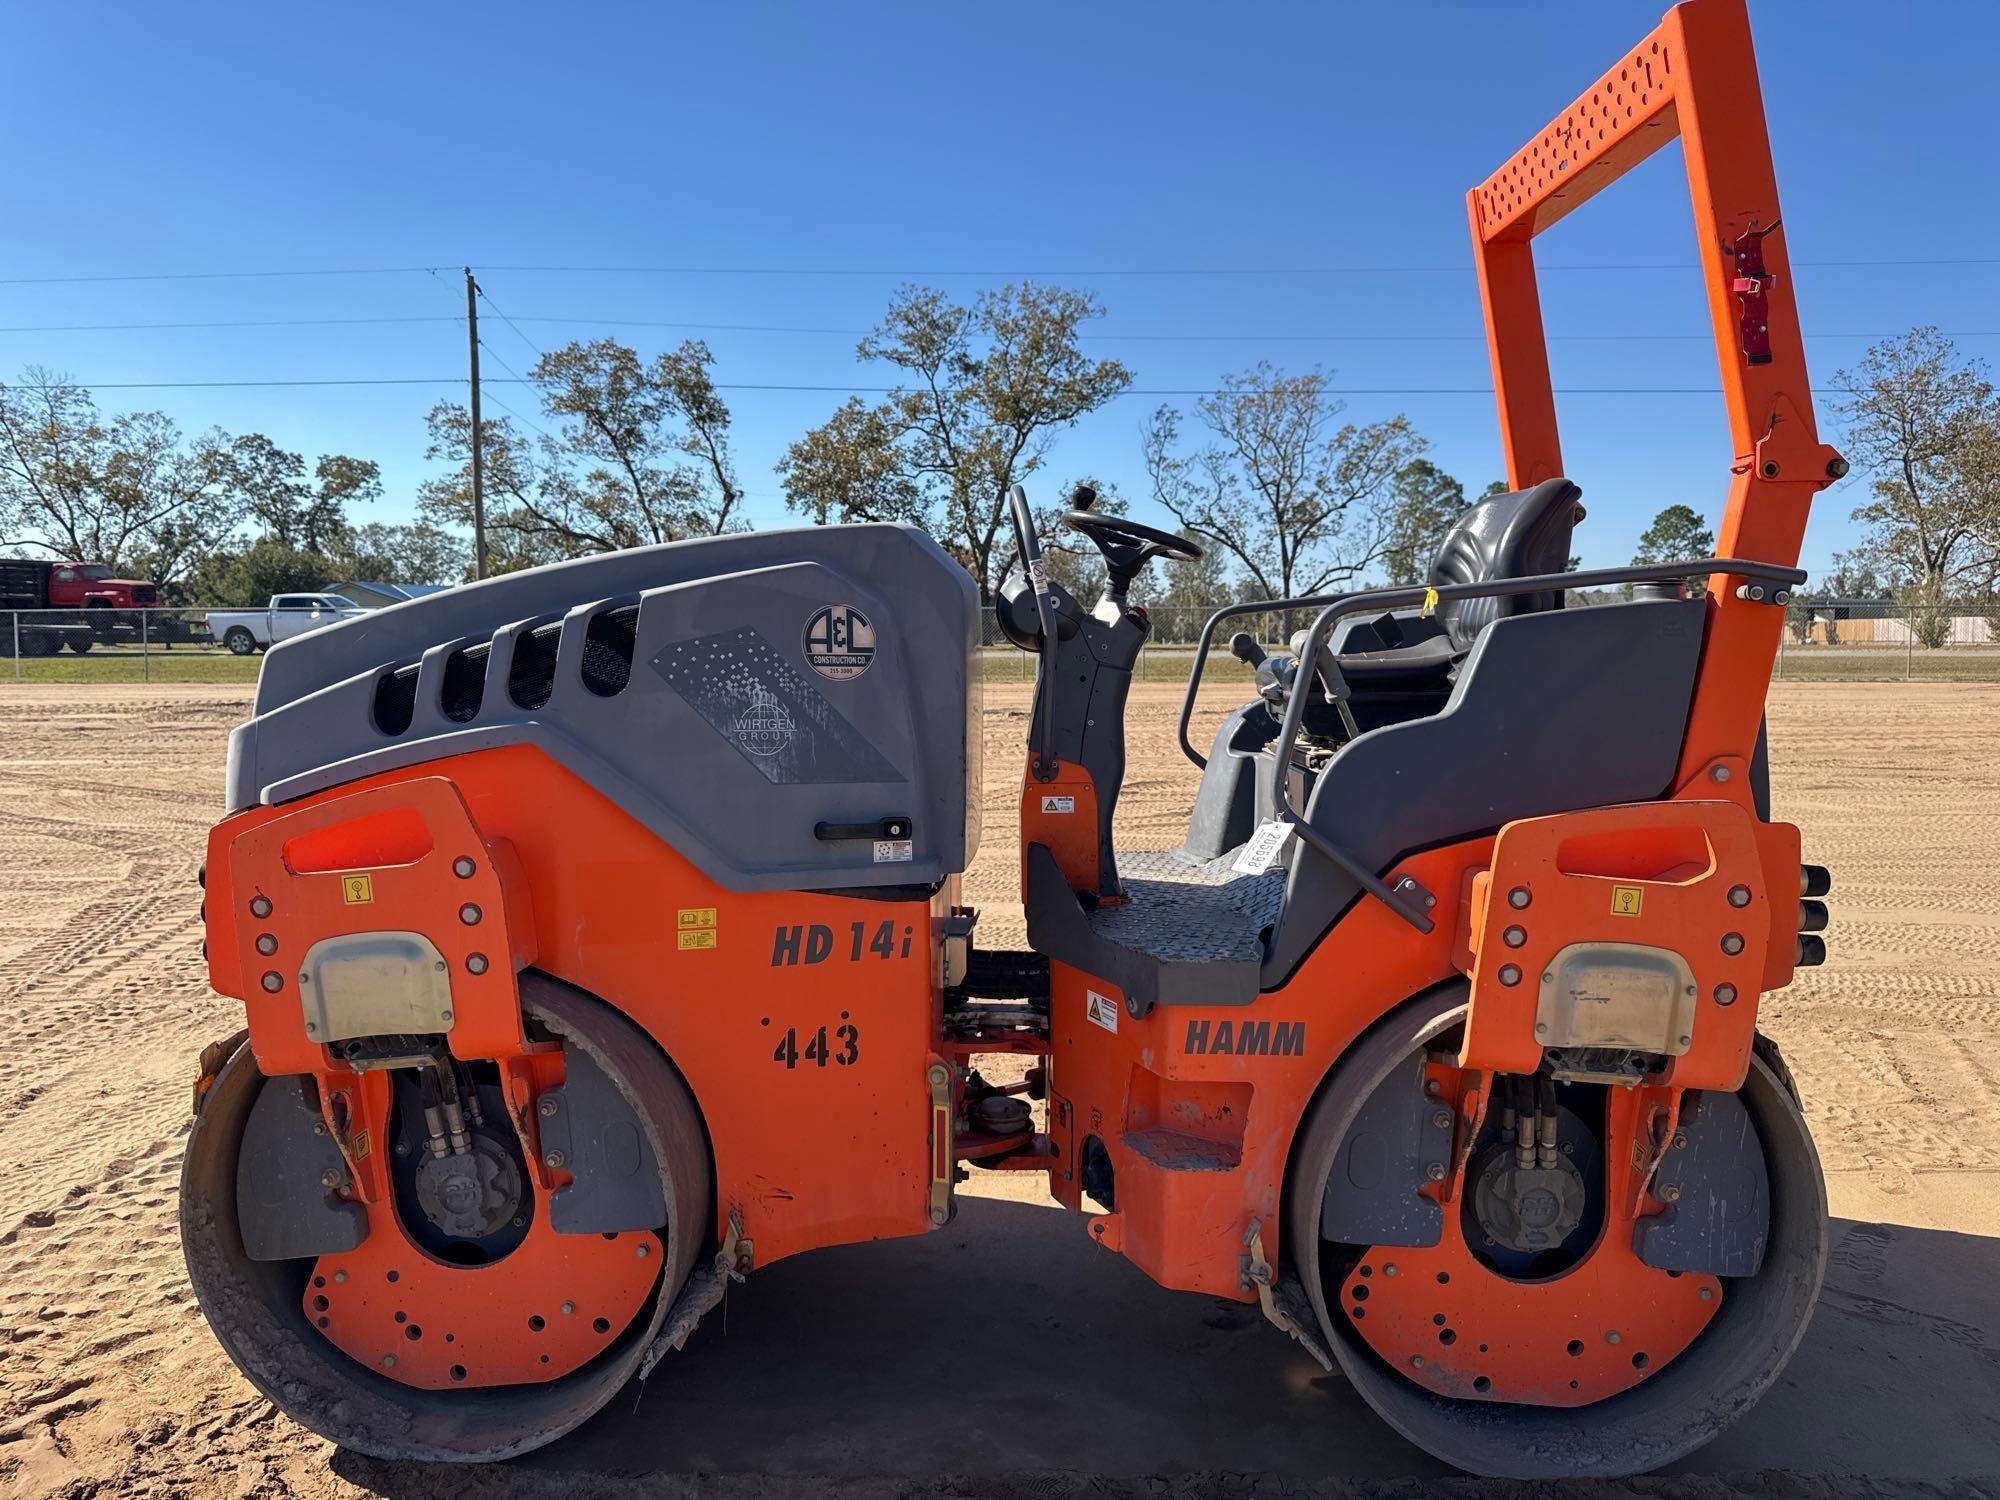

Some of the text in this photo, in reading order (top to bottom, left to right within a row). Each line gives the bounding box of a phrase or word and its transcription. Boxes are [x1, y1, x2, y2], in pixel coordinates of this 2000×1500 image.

[813, 655, 856, 665] CONSTRUCTION
[735, 718, 795, 730] WIRTGEN
[738, 731, 792, 741] GROUP
[1247, 832, 1281, 868] 205698
[771, 924, 834, 967] HD
[773, 1024, 859, 1069] 443
[1184, 1020, 1305, 1056] HAMM
